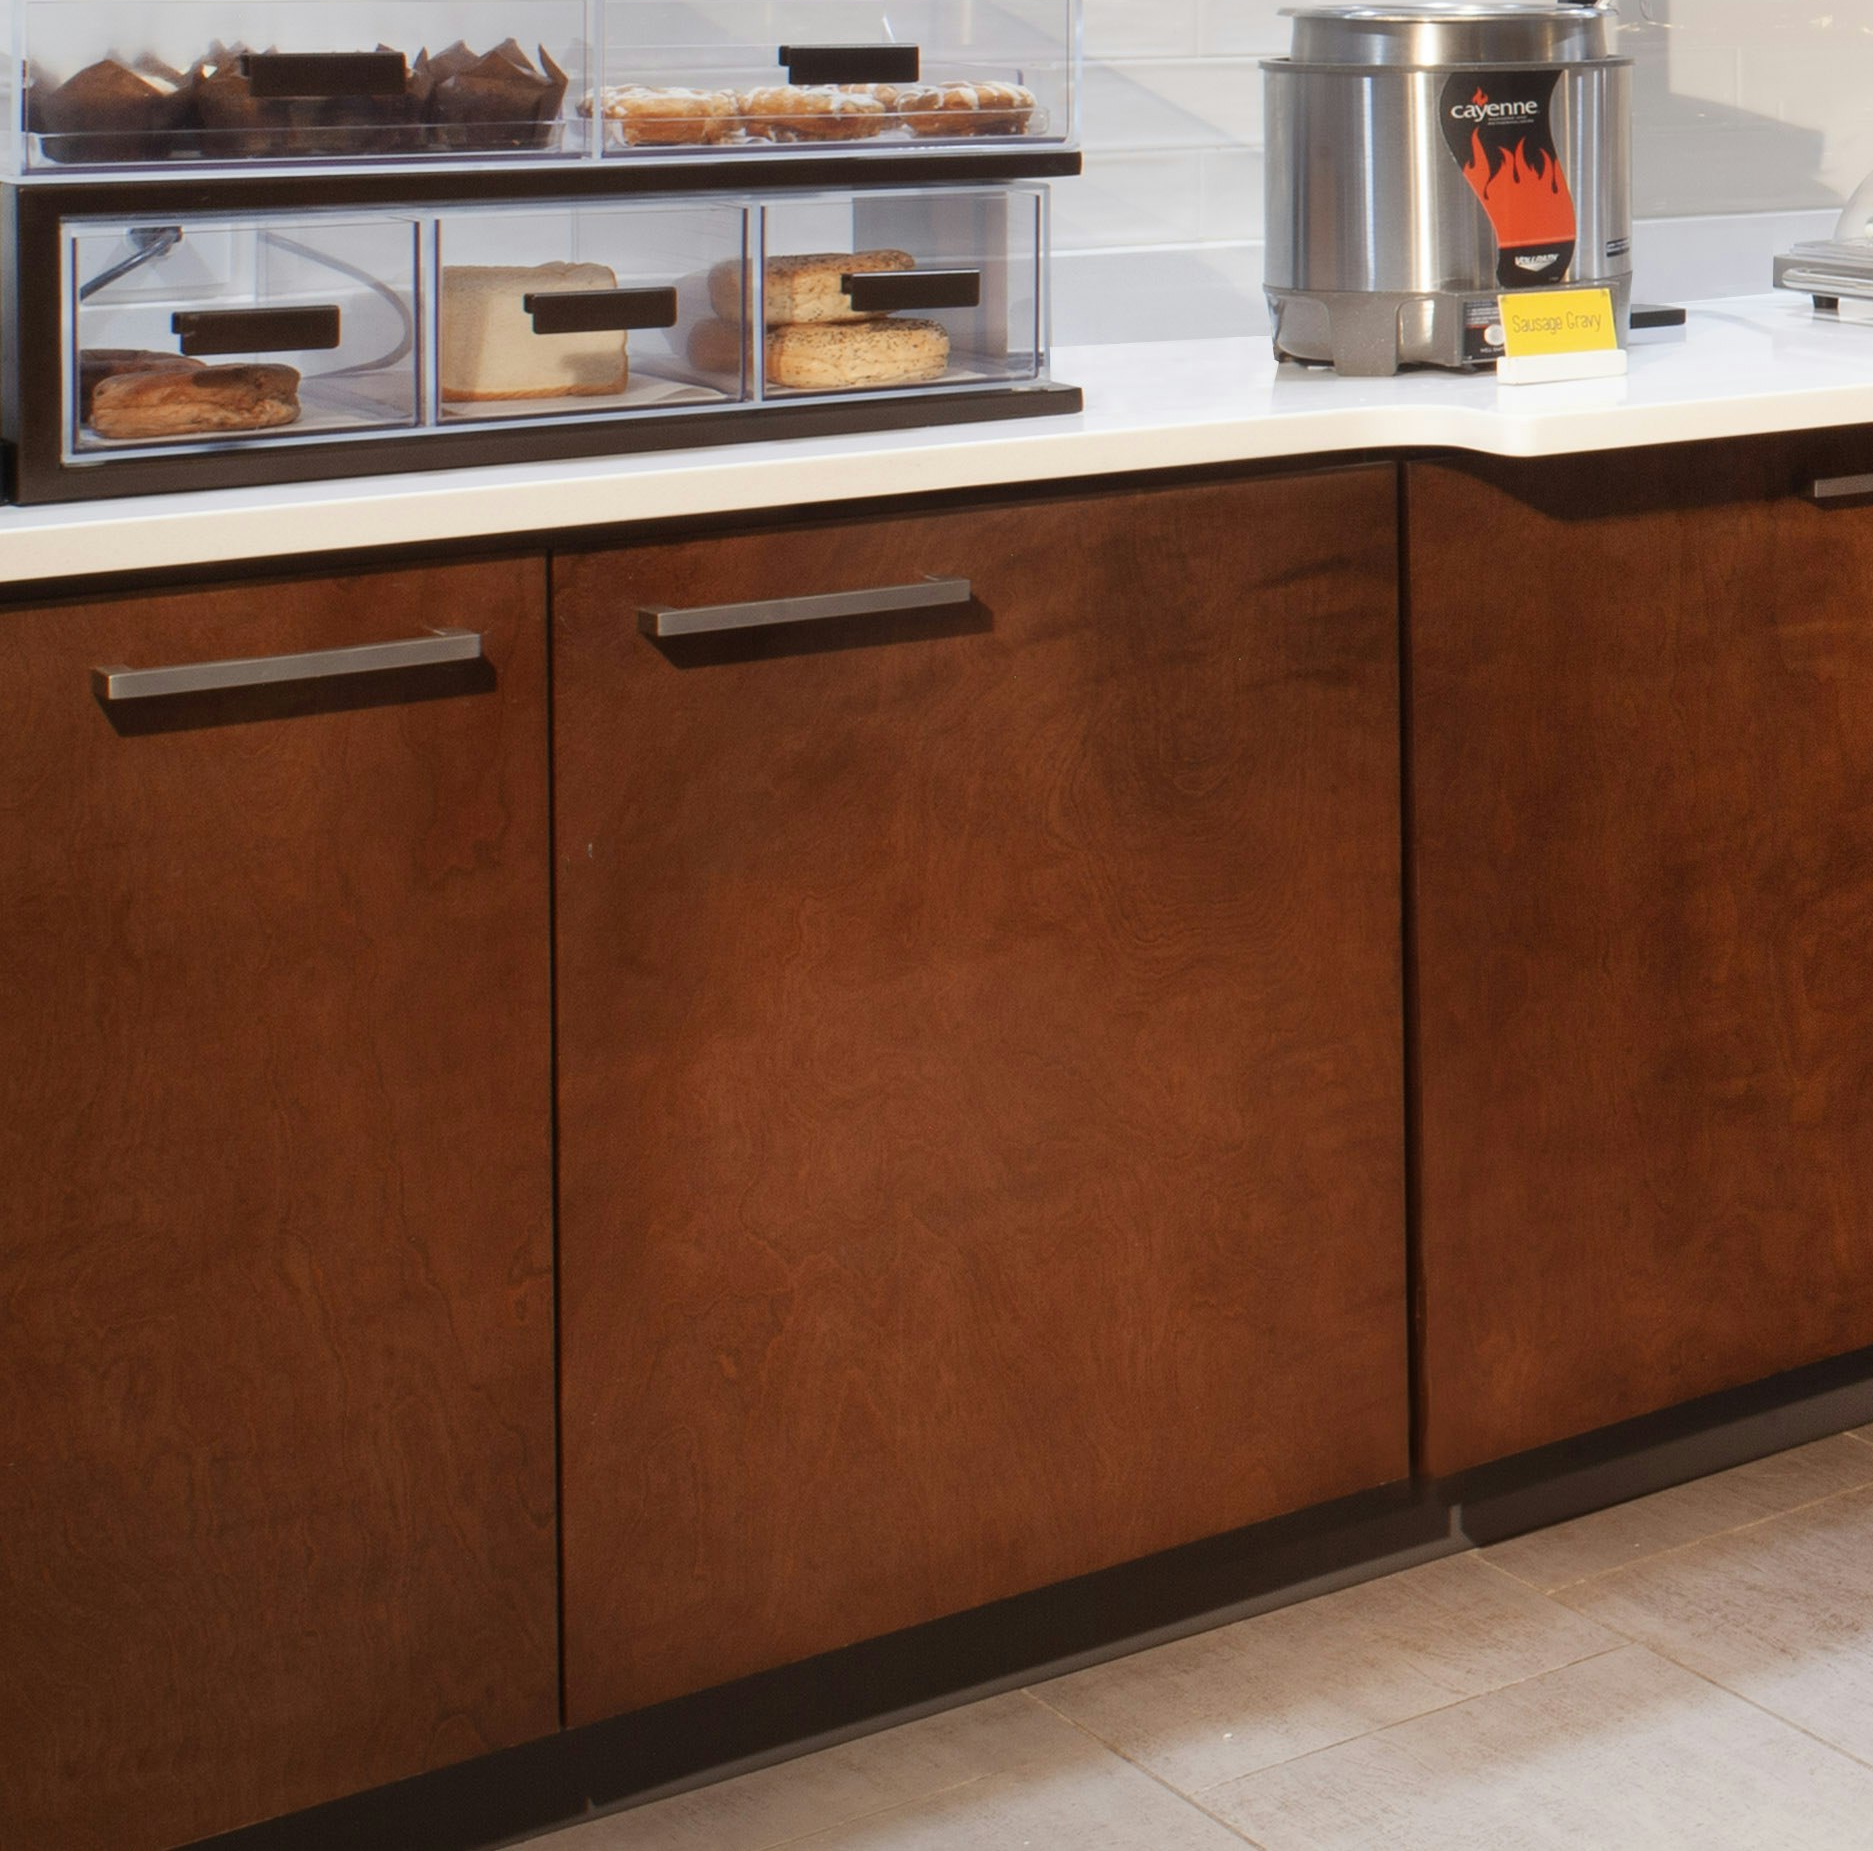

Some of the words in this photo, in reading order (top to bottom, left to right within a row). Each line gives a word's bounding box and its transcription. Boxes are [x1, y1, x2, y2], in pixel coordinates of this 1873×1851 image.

[1450, 100, 1538, 123] cayenne
[1511, 315, 1563, 335] Sausage
[1566, 311, 1602, 332] Gravy
